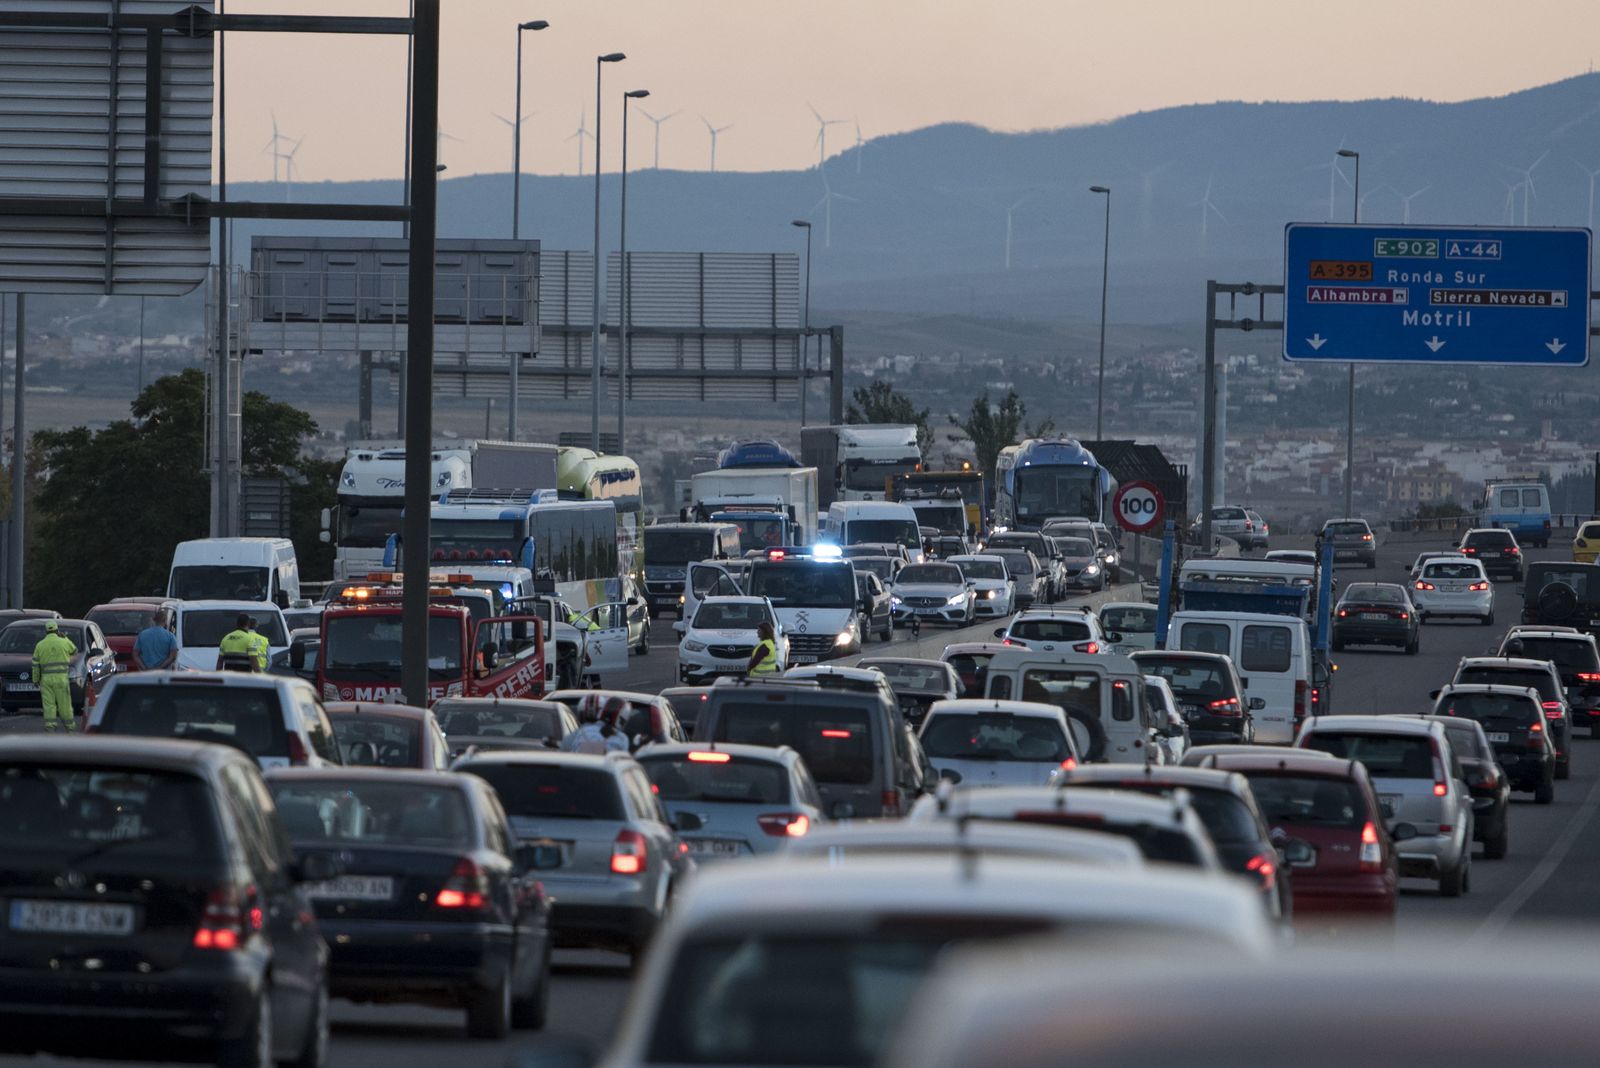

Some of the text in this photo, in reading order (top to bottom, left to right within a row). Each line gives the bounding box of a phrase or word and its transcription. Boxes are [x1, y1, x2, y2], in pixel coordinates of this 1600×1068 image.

[1377, 241, 1437, 255] E-902
[1449, 242, 1499, 257] A-44
[1313, 264, 1370, 278] A-395
[1387, 270, 1486, 285] Ronda Sur
[1311, 289, 1387, 302] Alhambra
[1433, 291, 1546, 305] Sierra Nevada
[1402, 310, 1471, 327] Motril
[1121, 497, 1156, 515] 100
[484, 658, 542, 698] PFRE
[355, 687, 444, 701] MAPE
